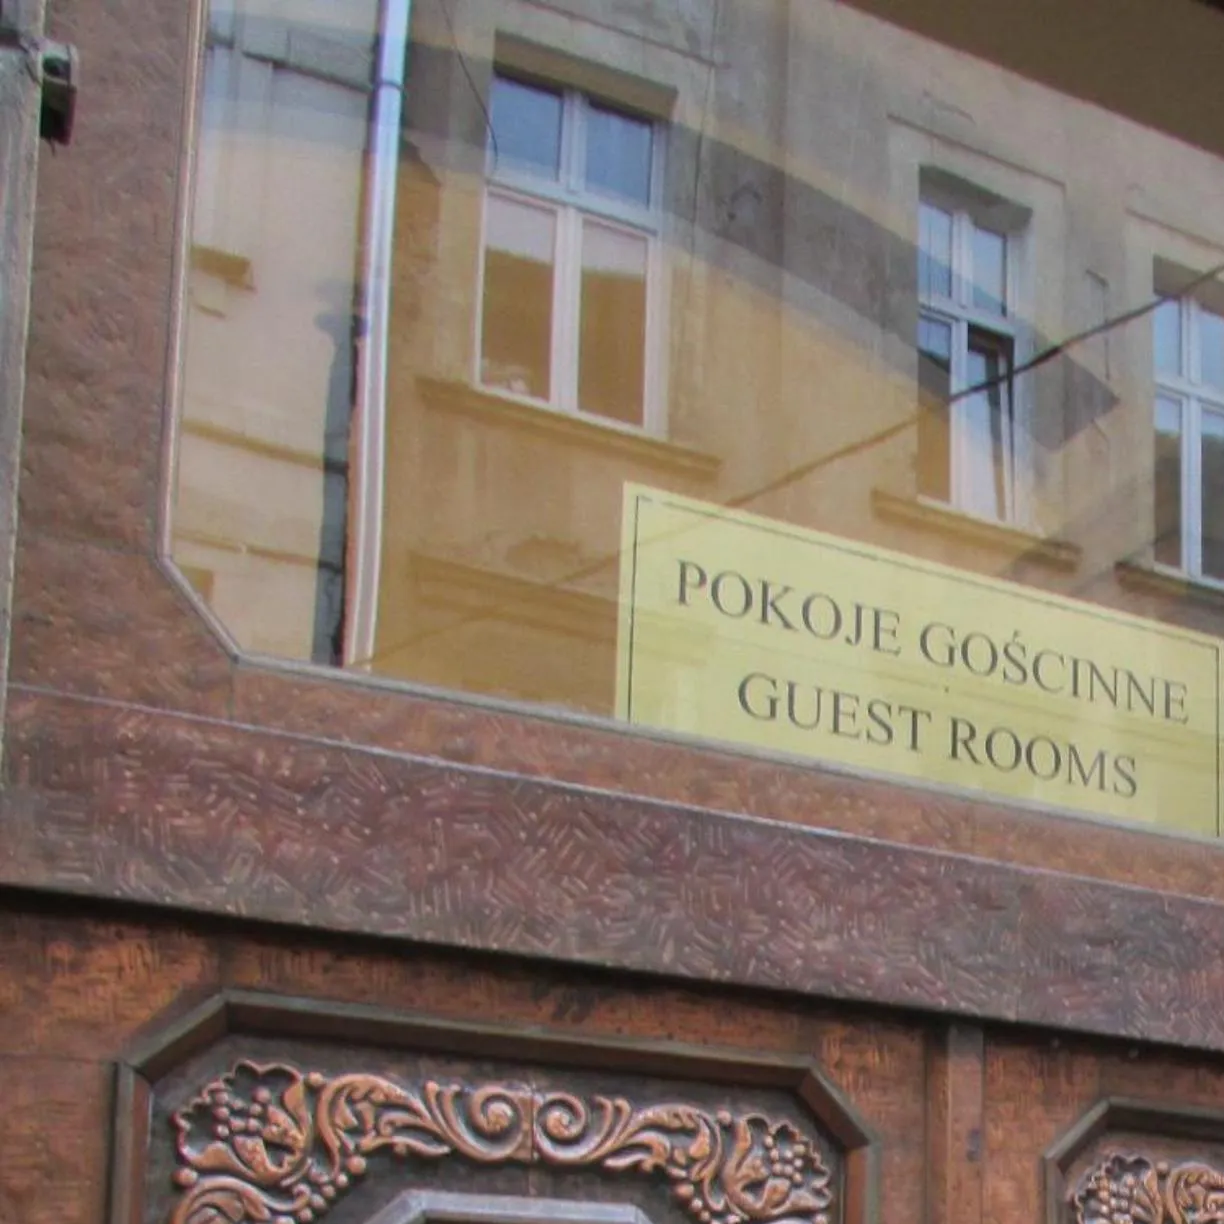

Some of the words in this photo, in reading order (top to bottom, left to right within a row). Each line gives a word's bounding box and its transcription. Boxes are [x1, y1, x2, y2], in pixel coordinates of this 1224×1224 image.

[675, 559, 902, 657] POKOJE
[919, 620, 1190, 725] GOŚCINNE
[737, 671, 932, 752] GUEST
[948, 717, 1138, 799] ROOMS
